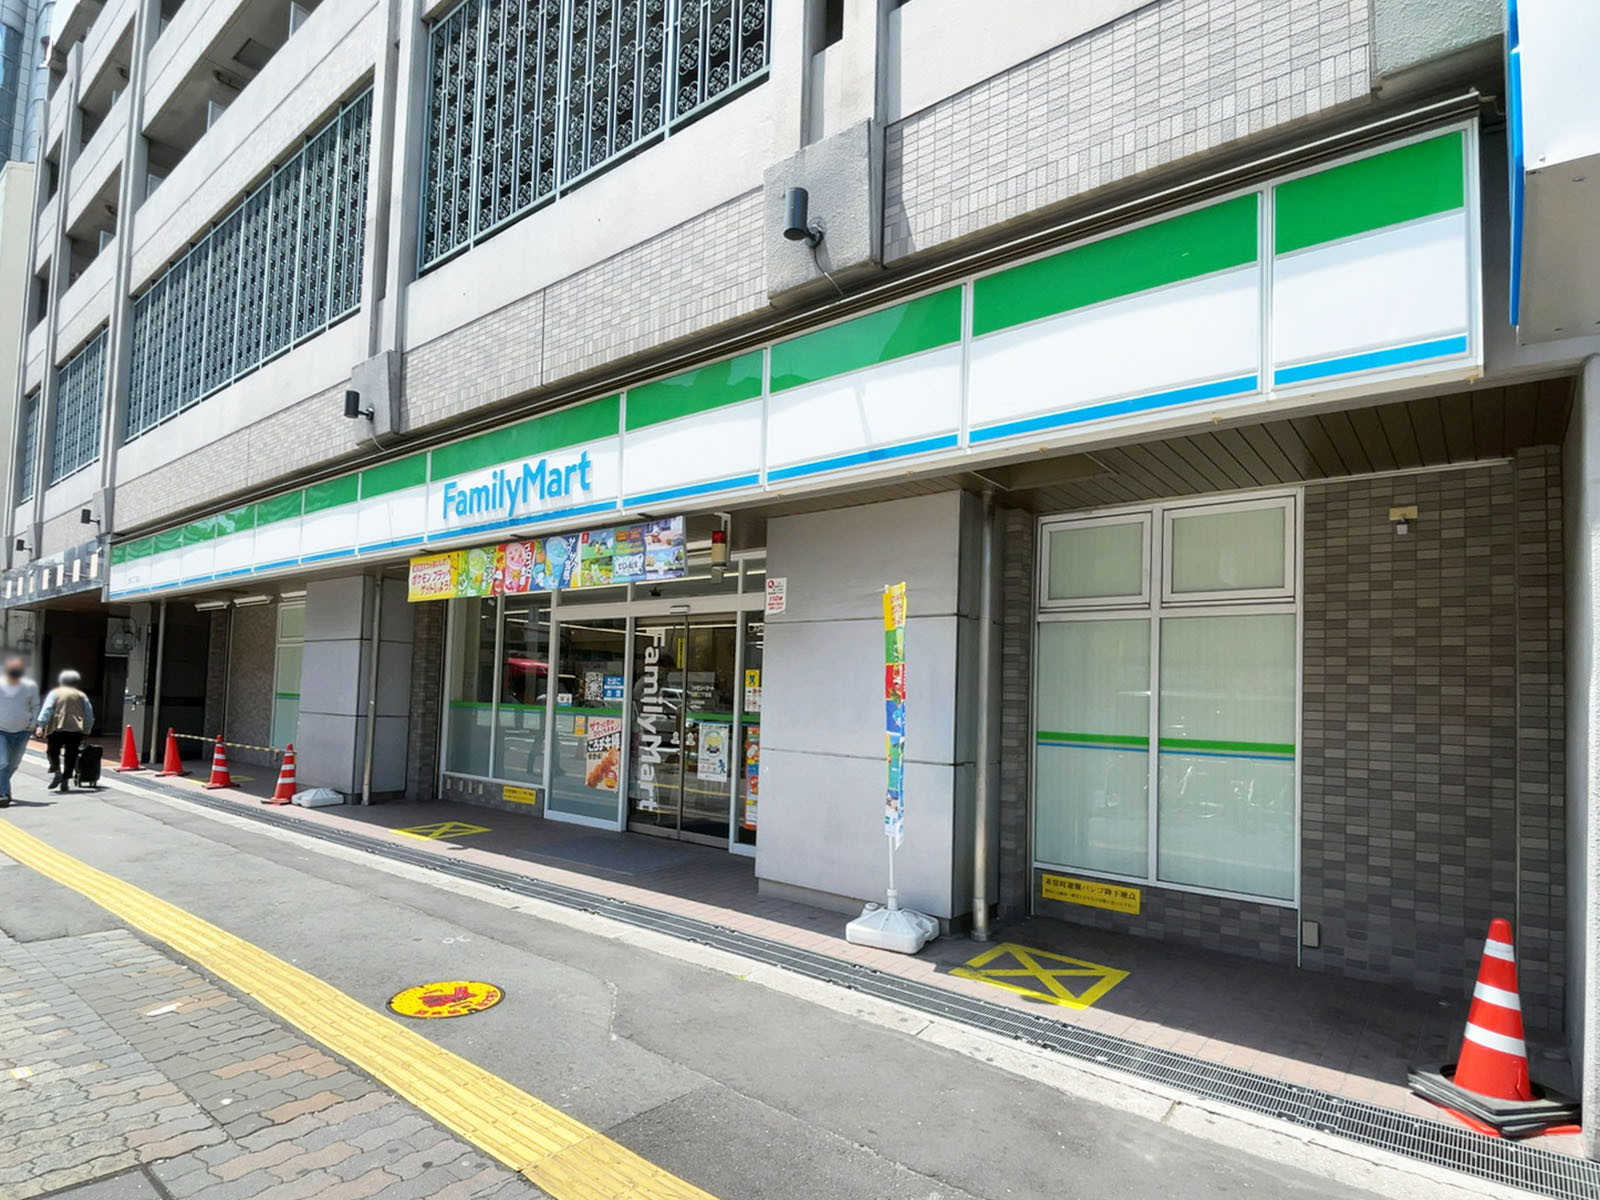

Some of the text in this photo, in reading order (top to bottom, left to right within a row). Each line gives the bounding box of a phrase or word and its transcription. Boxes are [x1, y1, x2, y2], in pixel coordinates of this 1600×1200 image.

[443, 450, 591, 520] FamilyMart
[607, 677, 622, 686] たばこ
[637, 629, 665, 811] FamilyMart
